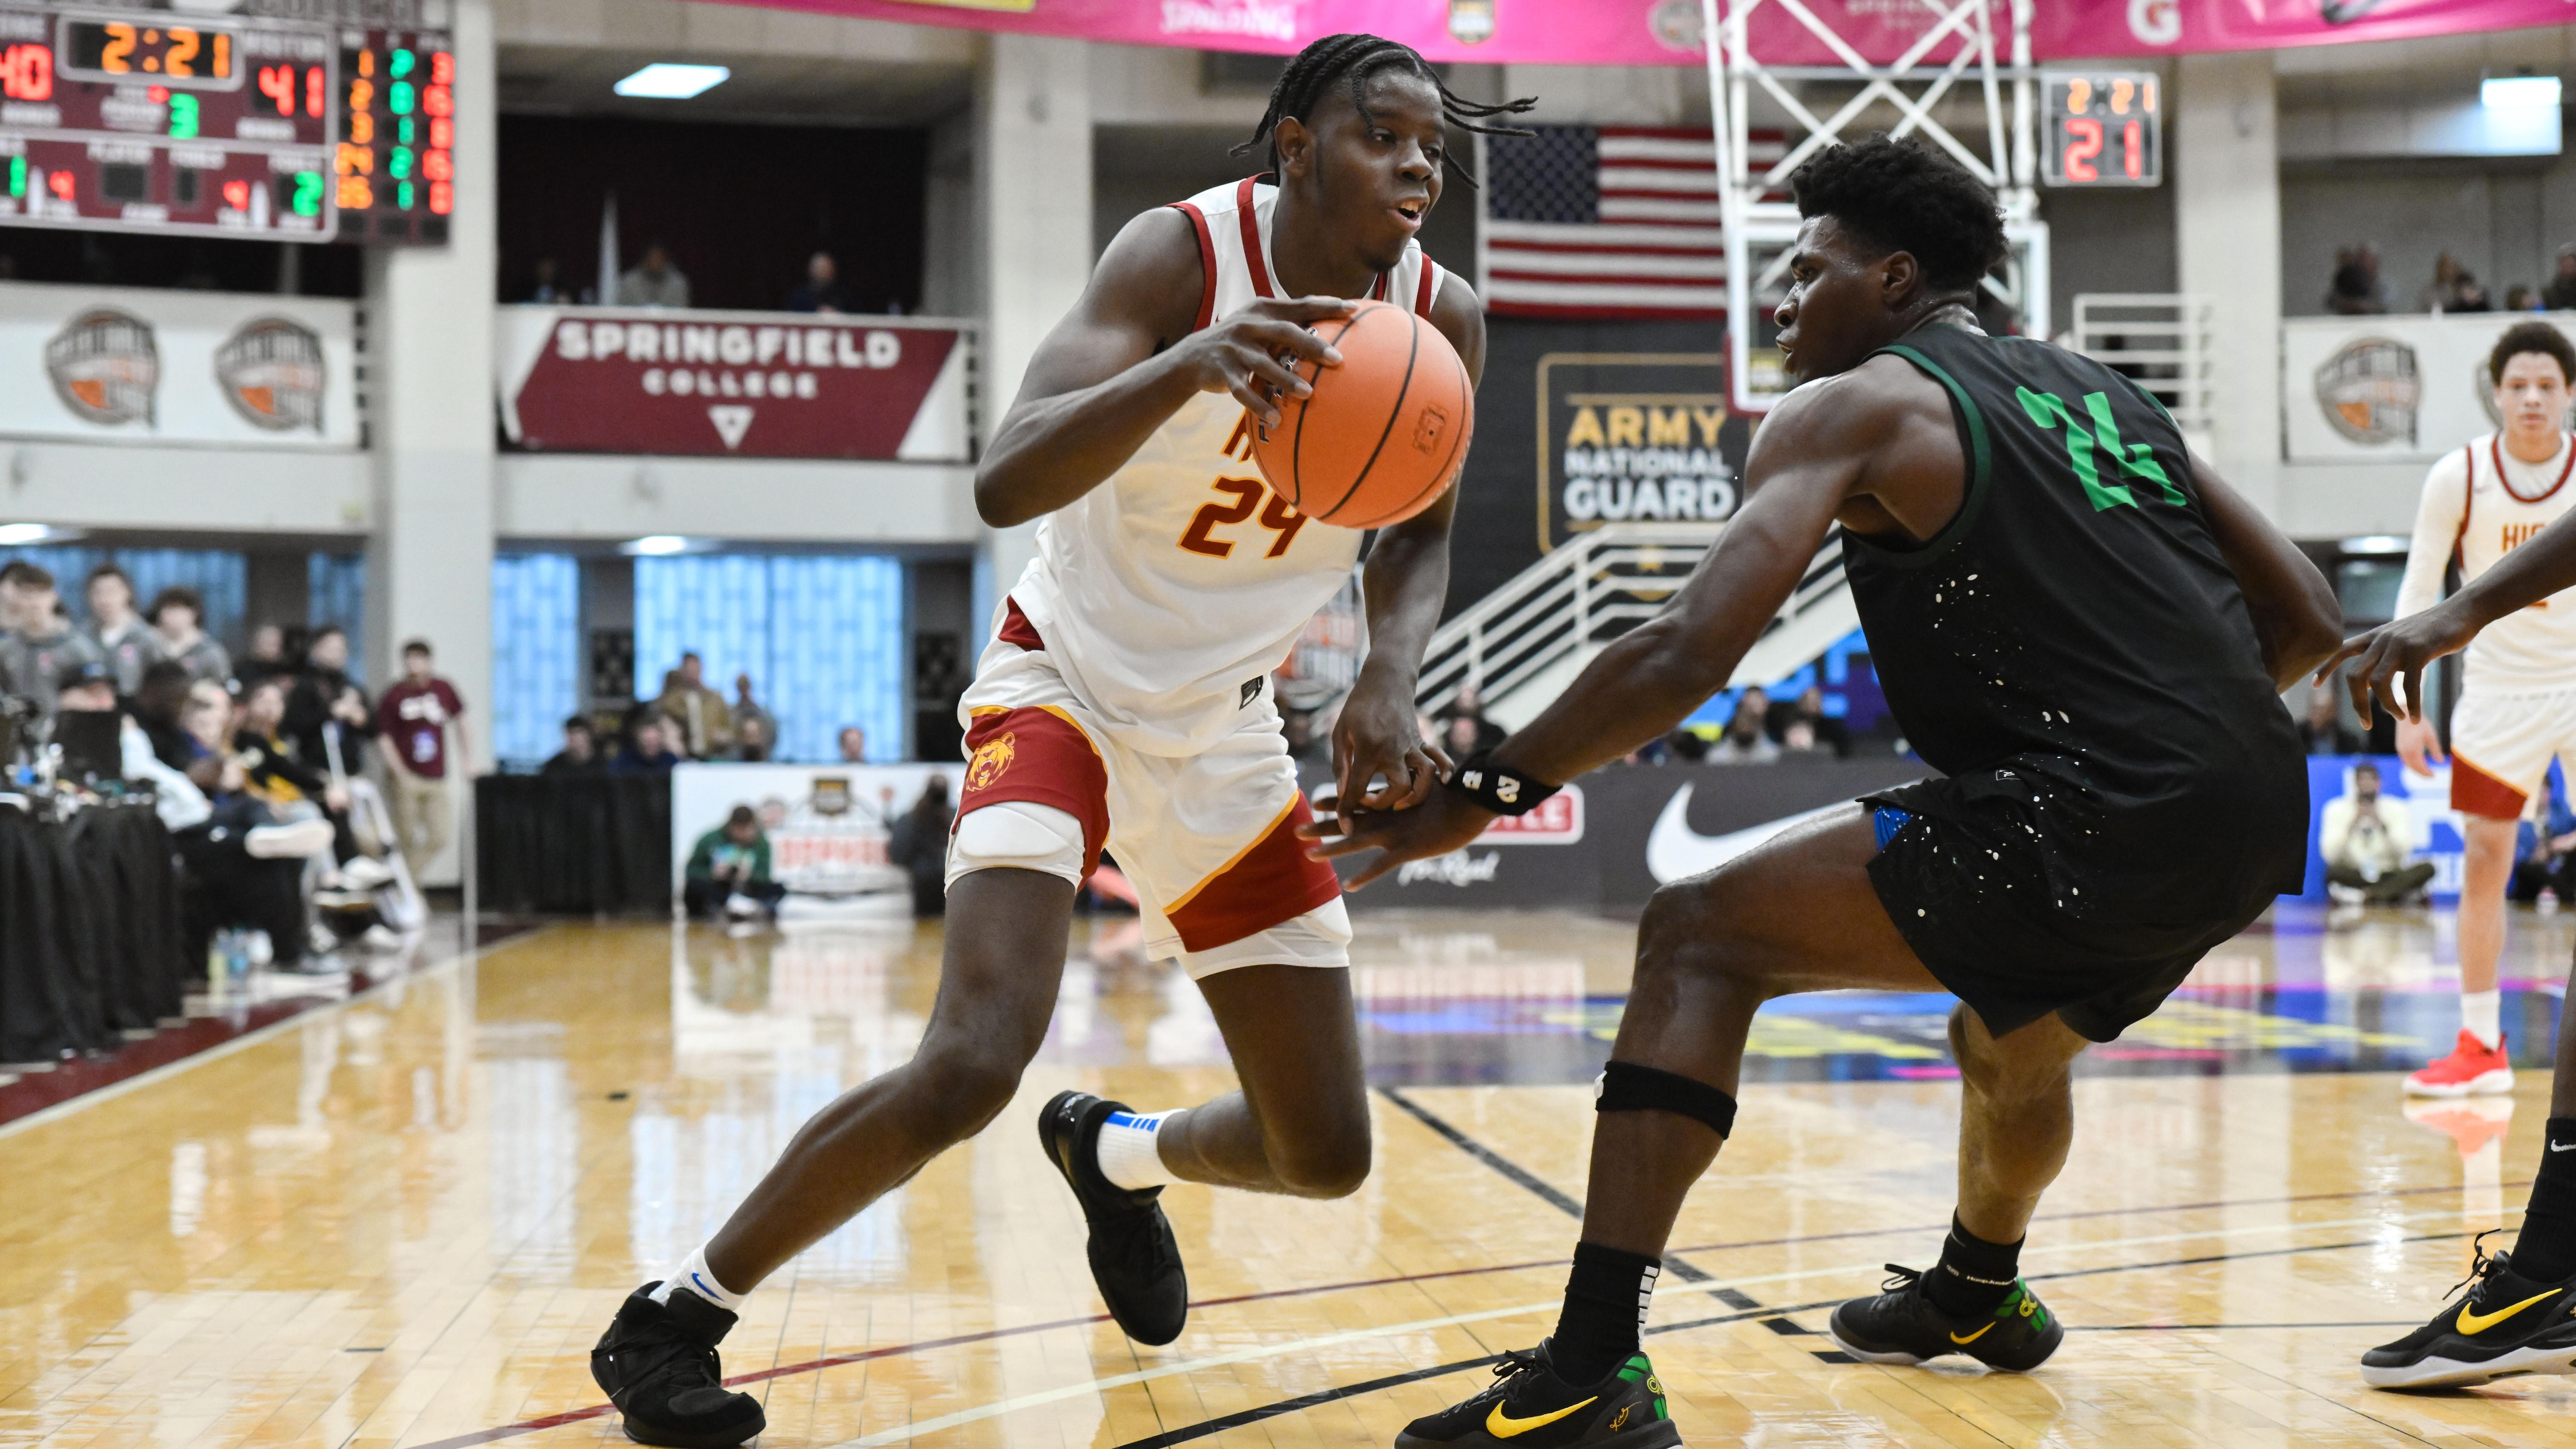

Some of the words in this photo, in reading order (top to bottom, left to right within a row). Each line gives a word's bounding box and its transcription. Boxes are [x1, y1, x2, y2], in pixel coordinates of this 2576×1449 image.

[102, 22, 231, 78] 2:21
[259, 64, 325, 118] 41
[169, 93, 199, 140] 3
[2064, 118, 2141, 182] 21
[293, 171, 324, 217] 2
[556, 320, 902, 369] SPRINGFIELD
[641, 368, 819, 399] COLLEGE
[1567, 406, 1727, 447] ARMY
[2015, 386, 2187, 512] 24
[1564, 447, 1733, 479] NATIONAL
[1176, 474, 1309, 559] 24
[1563, 477, 1735, 521] GUARD
